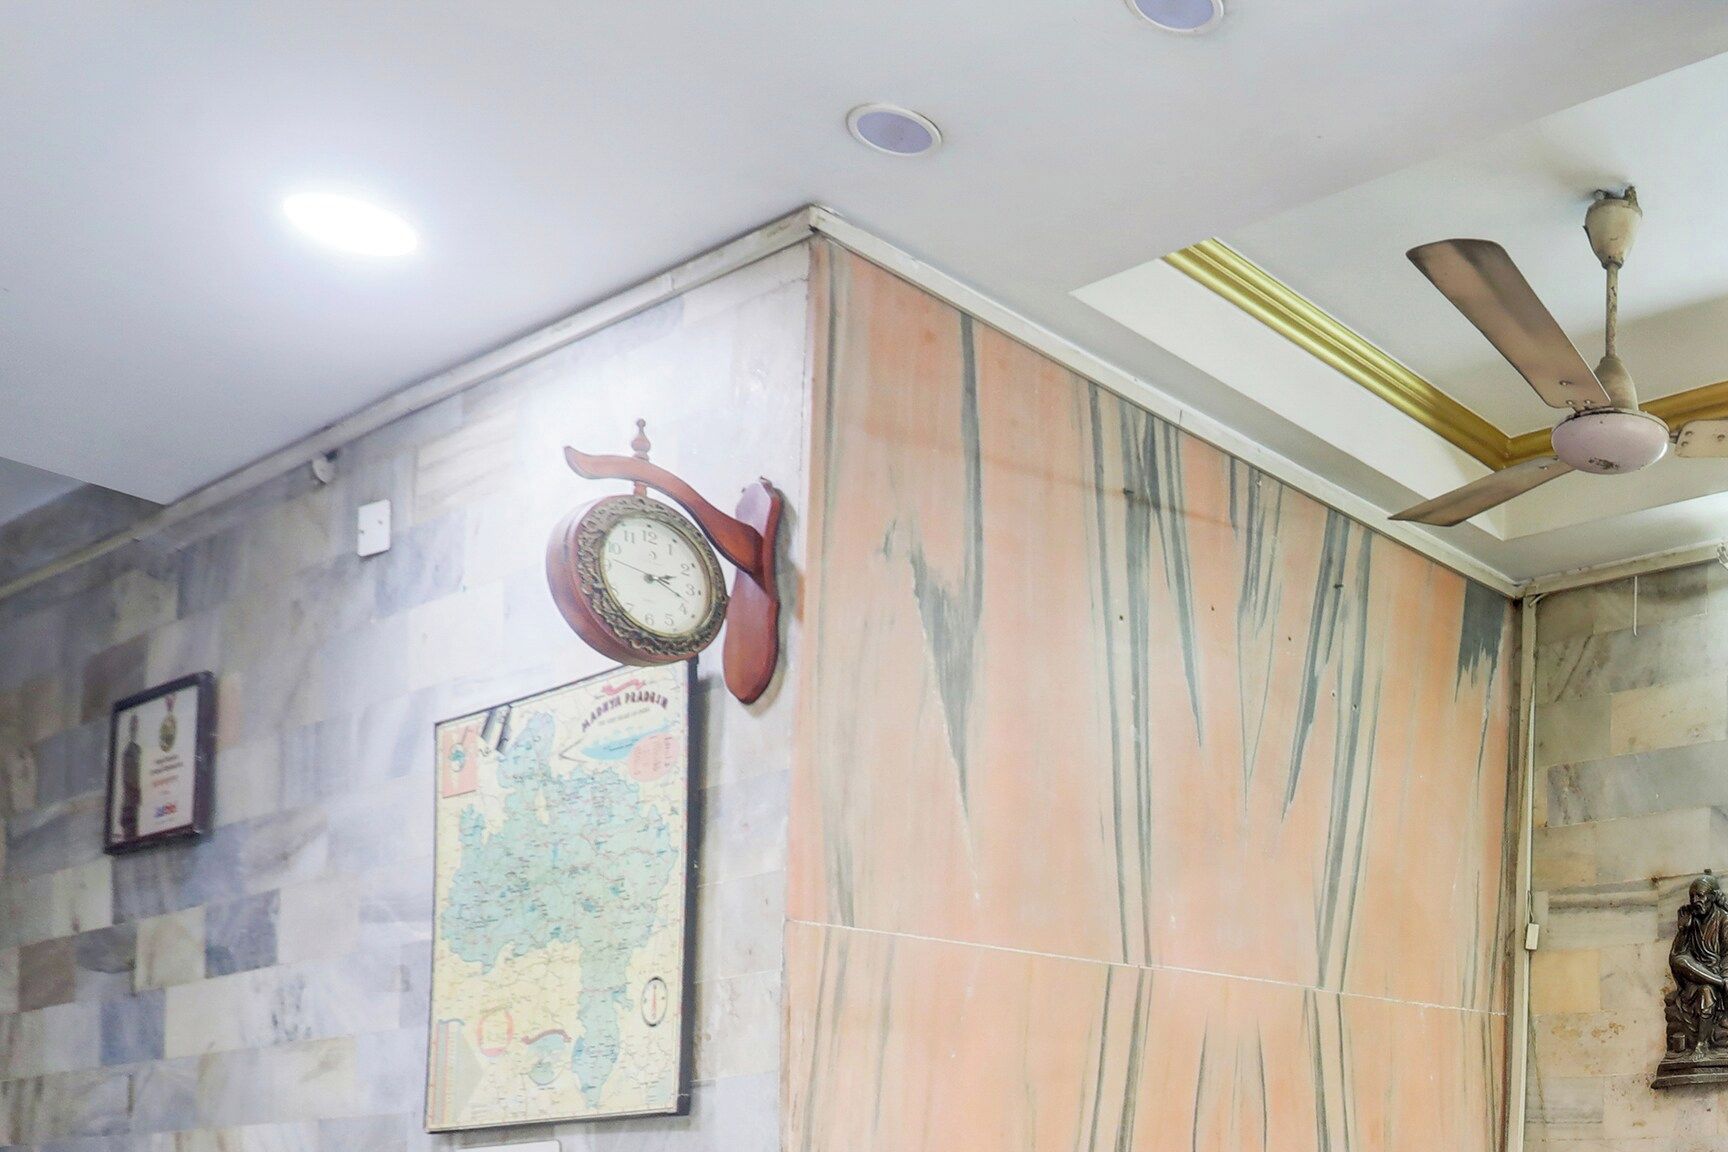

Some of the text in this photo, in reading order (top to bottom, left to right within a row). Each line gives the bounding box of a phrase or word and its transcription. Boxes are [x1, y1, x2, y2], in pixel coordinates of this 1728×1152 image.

[643, 530, 658, 545] 12
[681, 563, 691, 577] 2
[686, 583, 696, 597] 3
